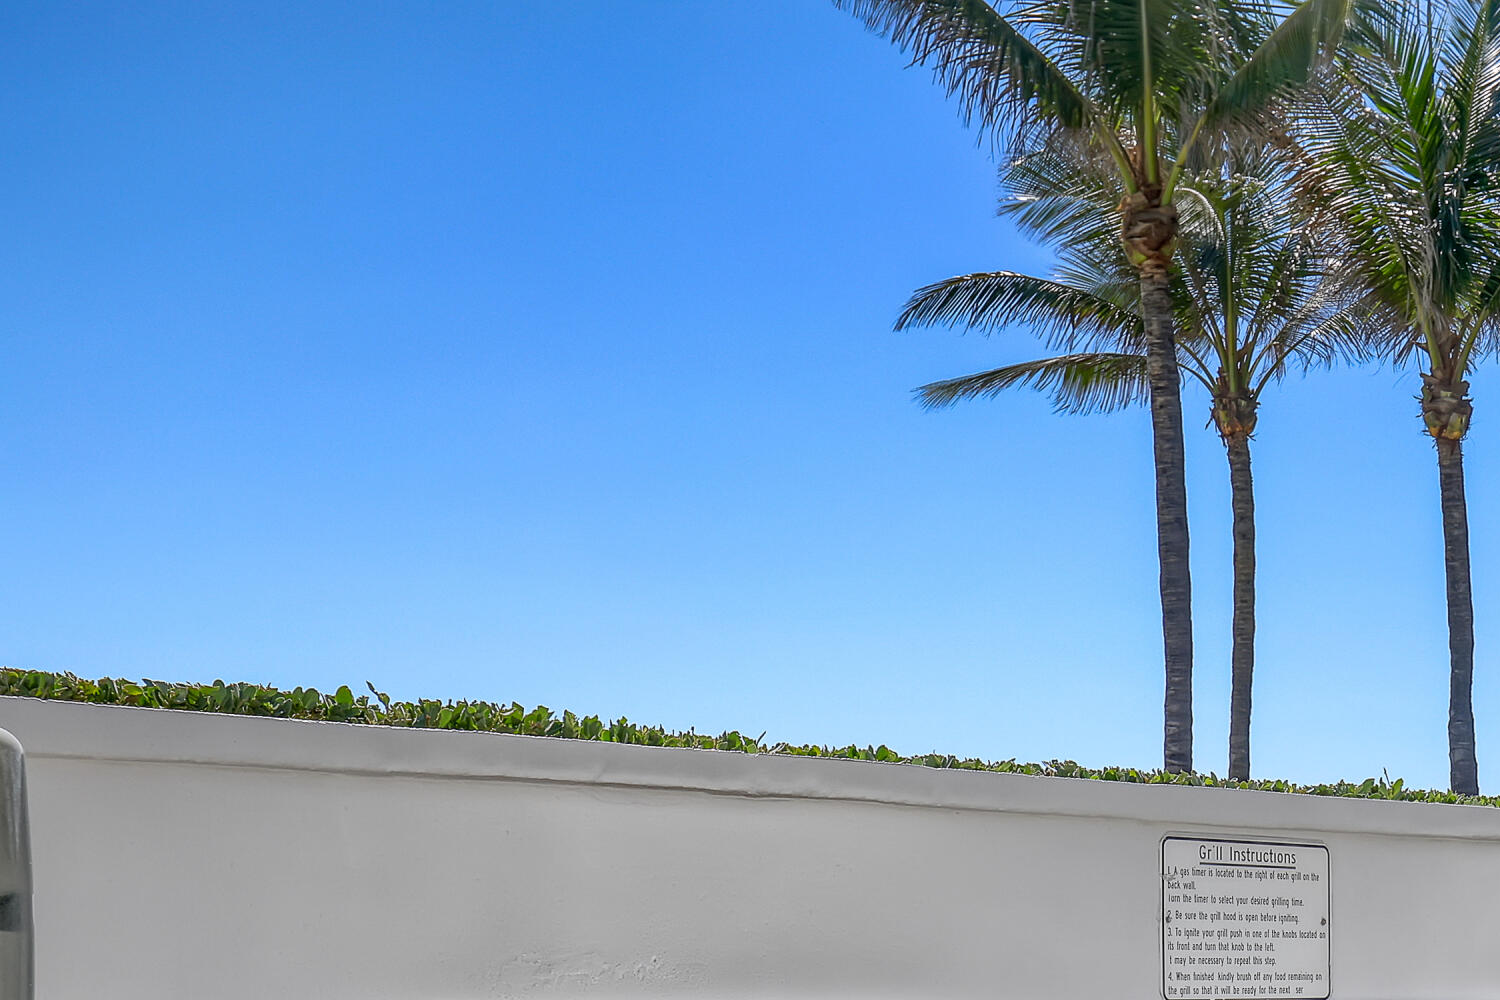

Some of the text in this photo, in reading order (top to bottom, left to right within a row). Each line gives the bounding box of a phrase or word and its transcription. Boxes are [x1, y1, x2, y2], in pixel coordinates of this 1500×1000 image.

[1200, 844, 1296, 864] Grll Instructions
[1174, 866, 1178, 875] A
[1180, 868, 1190, 878] gas
[1192, 867, 1206, 876] timer
[1208, 868, 1213, 876] is
[1216, 868, 1234, 878] located
[1236, 869, 1242, 878] to
[1244, 870, 1252, 878] the
[1255, 870, 1268, 881] right
[1270, 870, 1274, 879] of
[1277, 872, 1290, 880] each
[1291, 872, 1302, 882] grill
[1311, 873, 1320, 881] the
[1183, 894, 1192, 902] the
[1194, 894, 1208, 904] timer
[1211, 895, 1216, 904] to
[1218, 895, 1234, 904] select
[1236, 897, 1248, 906] your
[1250, 896, 1269, 905] desired
[1272, 896, 1290, 908] grilling
[1175, 910, 1182, 920] Be
[1199, 912, 1208, 920] the
[1210, 912, 1220, 922] grill
[1223, 912, 1236, 920] hood
[1238, 912, 1244, 920] is
[1246, 914, 1258, 923] open
[1260, 913, 1276, 922] before
[1175, 927, 1182, 936] To
[1184, 928, 1200, 939] ignite
[1202, 930, 1214, 938] your
[1216, 928, 1228, 939] grill
[1230, 929, 1242, 938] push
[1245, 930, 1250, 938] in
[1264, 930, 1270, 938] of
[1272, 930, 1280, 938] the
[1300, 930, 1318, 939] located
[1177, 942, 1190, 950] front
[1192, 942, 1202, 950] and
[1205, 942, 1216, 950] turn
[1218, 942, 1229, 950] that
[1232, 942, 1244, 951] knob
[1246, 942, 1252, 952] to
[1254, 943, 1262, 952] the
[1174, 957, 1186, 966] may
[1189, 956, 1196, 964] be
[1198, 958, 1224, 966] necessary
[1226, 956, 1232, 964] to
[1234, 956, 1250, 966] repeat
[1253, 956, 1262, 964] this
[1176, 972, 1190, 980] When
[1218, 972, 1234, 982] kindly
[1237, 972, 1252, 980] brush
[1262, 974, 1272, 983] any
[1275, 972, 1286, 980] food
[1288, 972, 1314, 983] remaining
[1168, 986, 1178, 994] the
[1180, 986, 1190, 997] grill
[1202, 986, 1212, 994] that
[1214, 986, 1219, 994] it
[1221, 986, 1230, 994] will
[1232, 986, 1240, 994] be
[1242, 986, 1256, 996] ready
[1268, 986, 1276, 994] the
[1279, 986, 1290, 994] next
